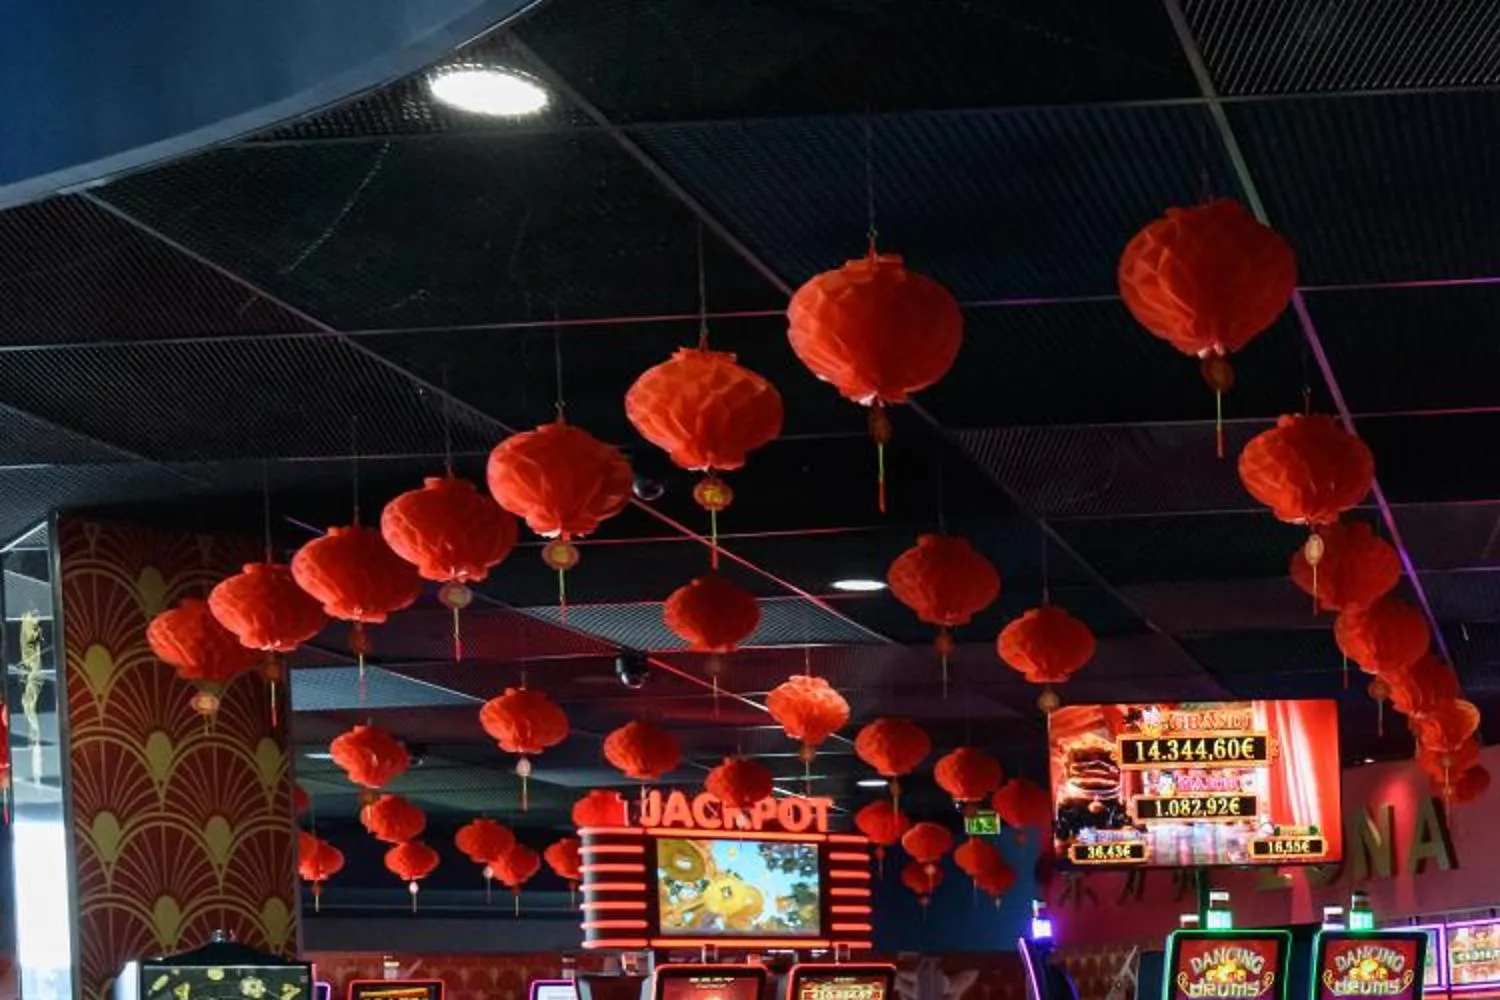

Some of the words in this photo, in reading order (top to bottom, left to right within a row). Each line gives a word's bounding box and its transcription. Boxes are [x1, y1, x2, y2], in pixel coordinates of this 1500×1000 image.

[1136, 738, 1255, 760] 14.344,60€
[640, 790, 833, 833] JACKPOT
[1154, 798, 1241, 817] 1.082,92€
[1189, 947, 1266, 975] DANCING
[1334, 946, 1406, 974] DANCING
